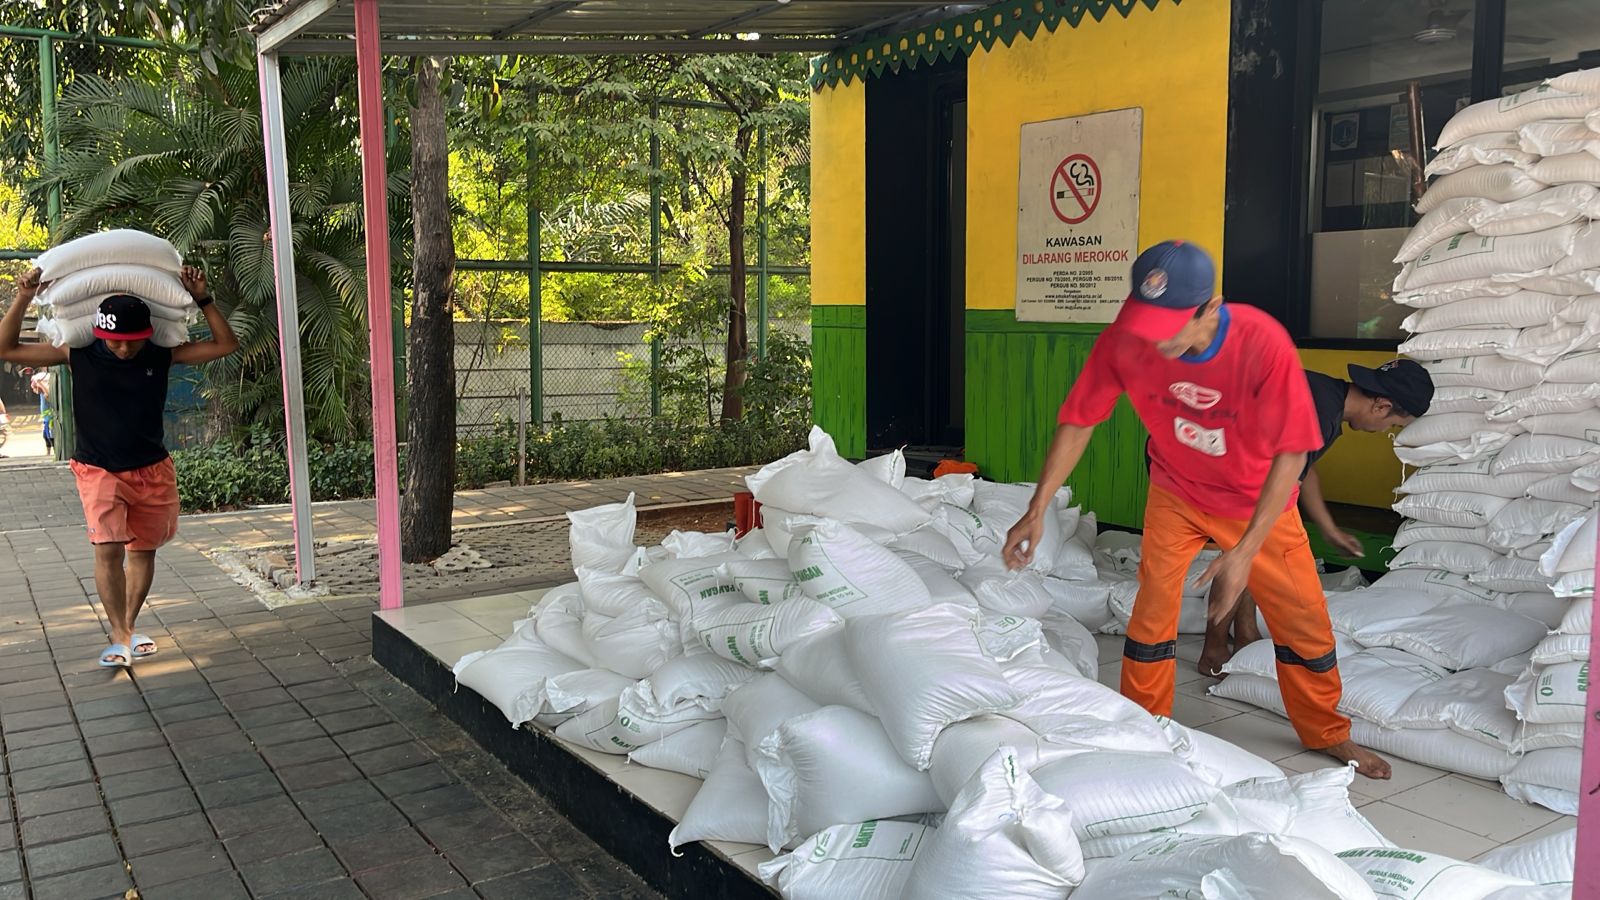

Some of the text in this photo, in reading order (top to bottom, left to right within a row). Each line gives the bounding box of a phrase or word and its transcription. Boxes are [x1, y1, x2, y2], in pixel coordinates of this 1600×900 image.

[1046, 235, 1102, 247] KAWASAN
[1022, 250, 1129, 265] DILARANG MEROKOK
[700, 584, 735, 600] PANGAN
[852, 820, 878, 849] BANTU
[1367, 849, 1427, 864] PANGAN
